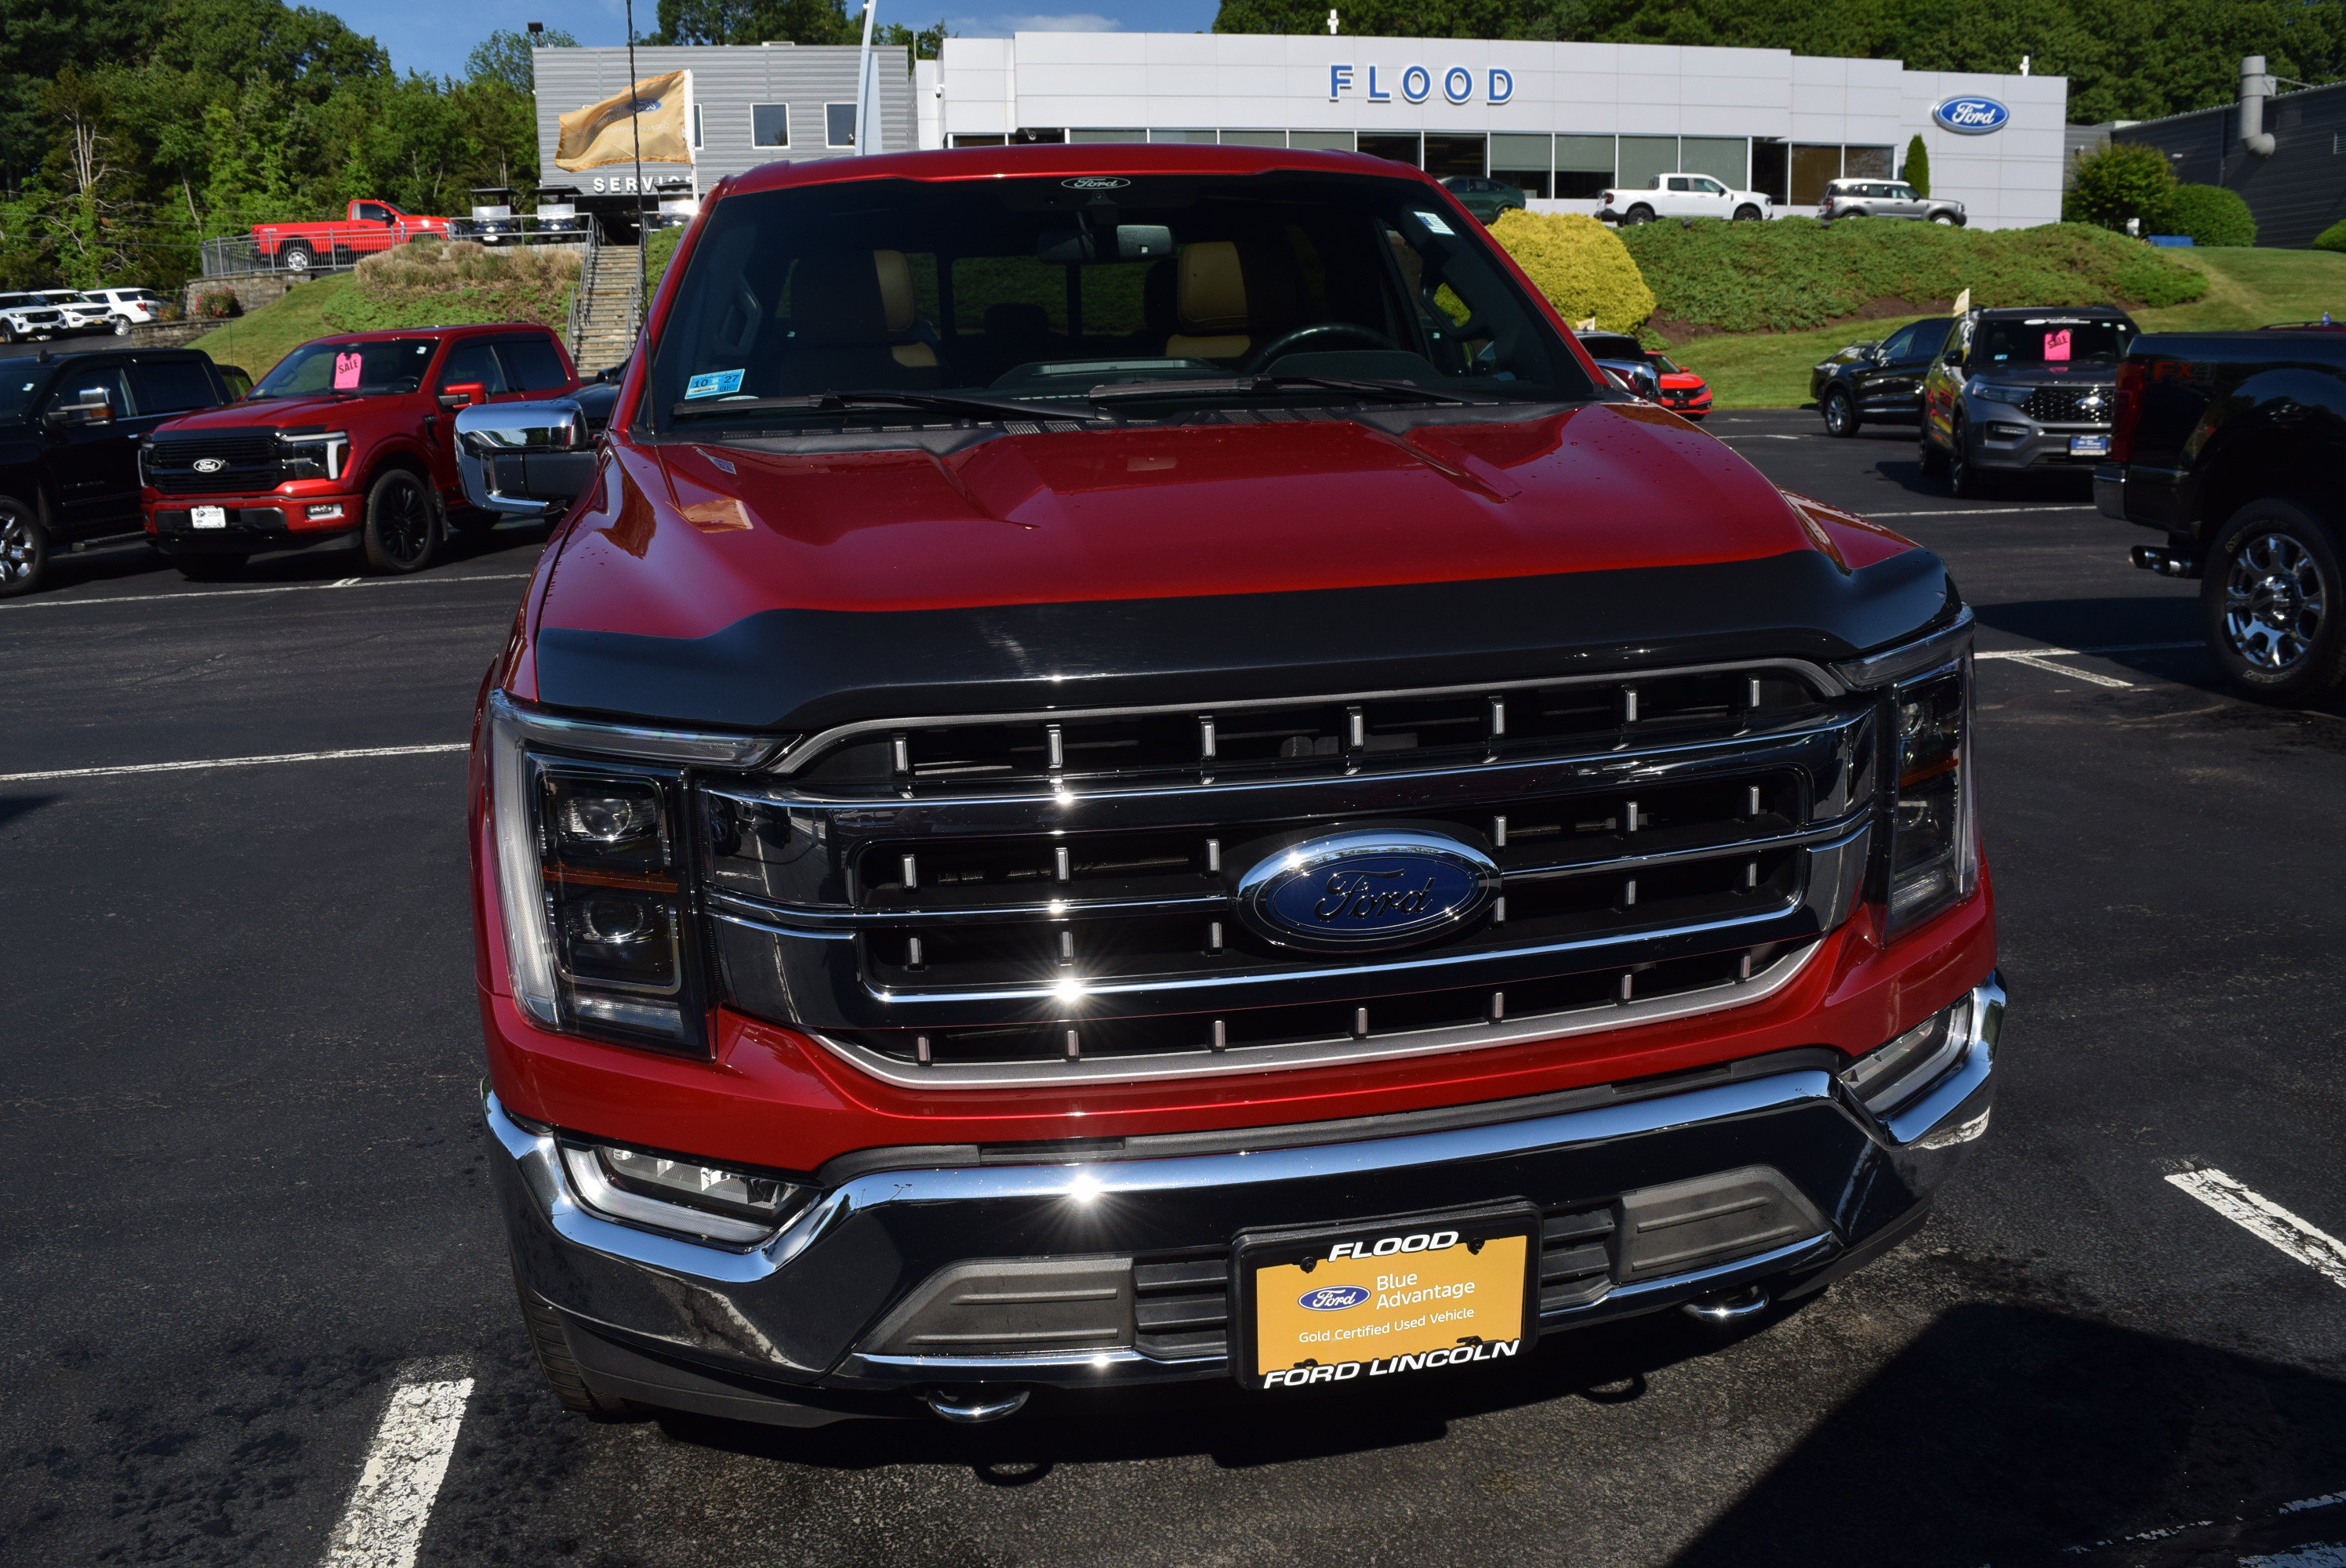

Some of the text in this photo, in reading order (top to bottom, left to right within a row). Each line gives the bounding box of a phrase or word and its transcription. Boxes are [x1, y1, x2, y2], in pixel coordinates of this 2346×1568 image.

[1329, 64, 1515, 103] FLOOD
[1952, 102, 1996, 124] Ford
[2047, 335, 2068, 349] SALE
[338, 359, 358, 374] SALE
[693, 379, 708, 388] 10
[723, 374, 739, 383] 27
[1314, 868, 1436, 922] Ford
[1327, 1231, 1459, 1263] FLOOD
[1376, 1272, 1418, 1291] Blue
[1312, 1288, 1357, 1308] Ford
[1375, 1280, 1476, 1310] Advantage
[1298, 1307, 1475, 1343] Gold Certified Used Vehicle
[1263, 1339, 1520, 1389] FORD LINCOLN
